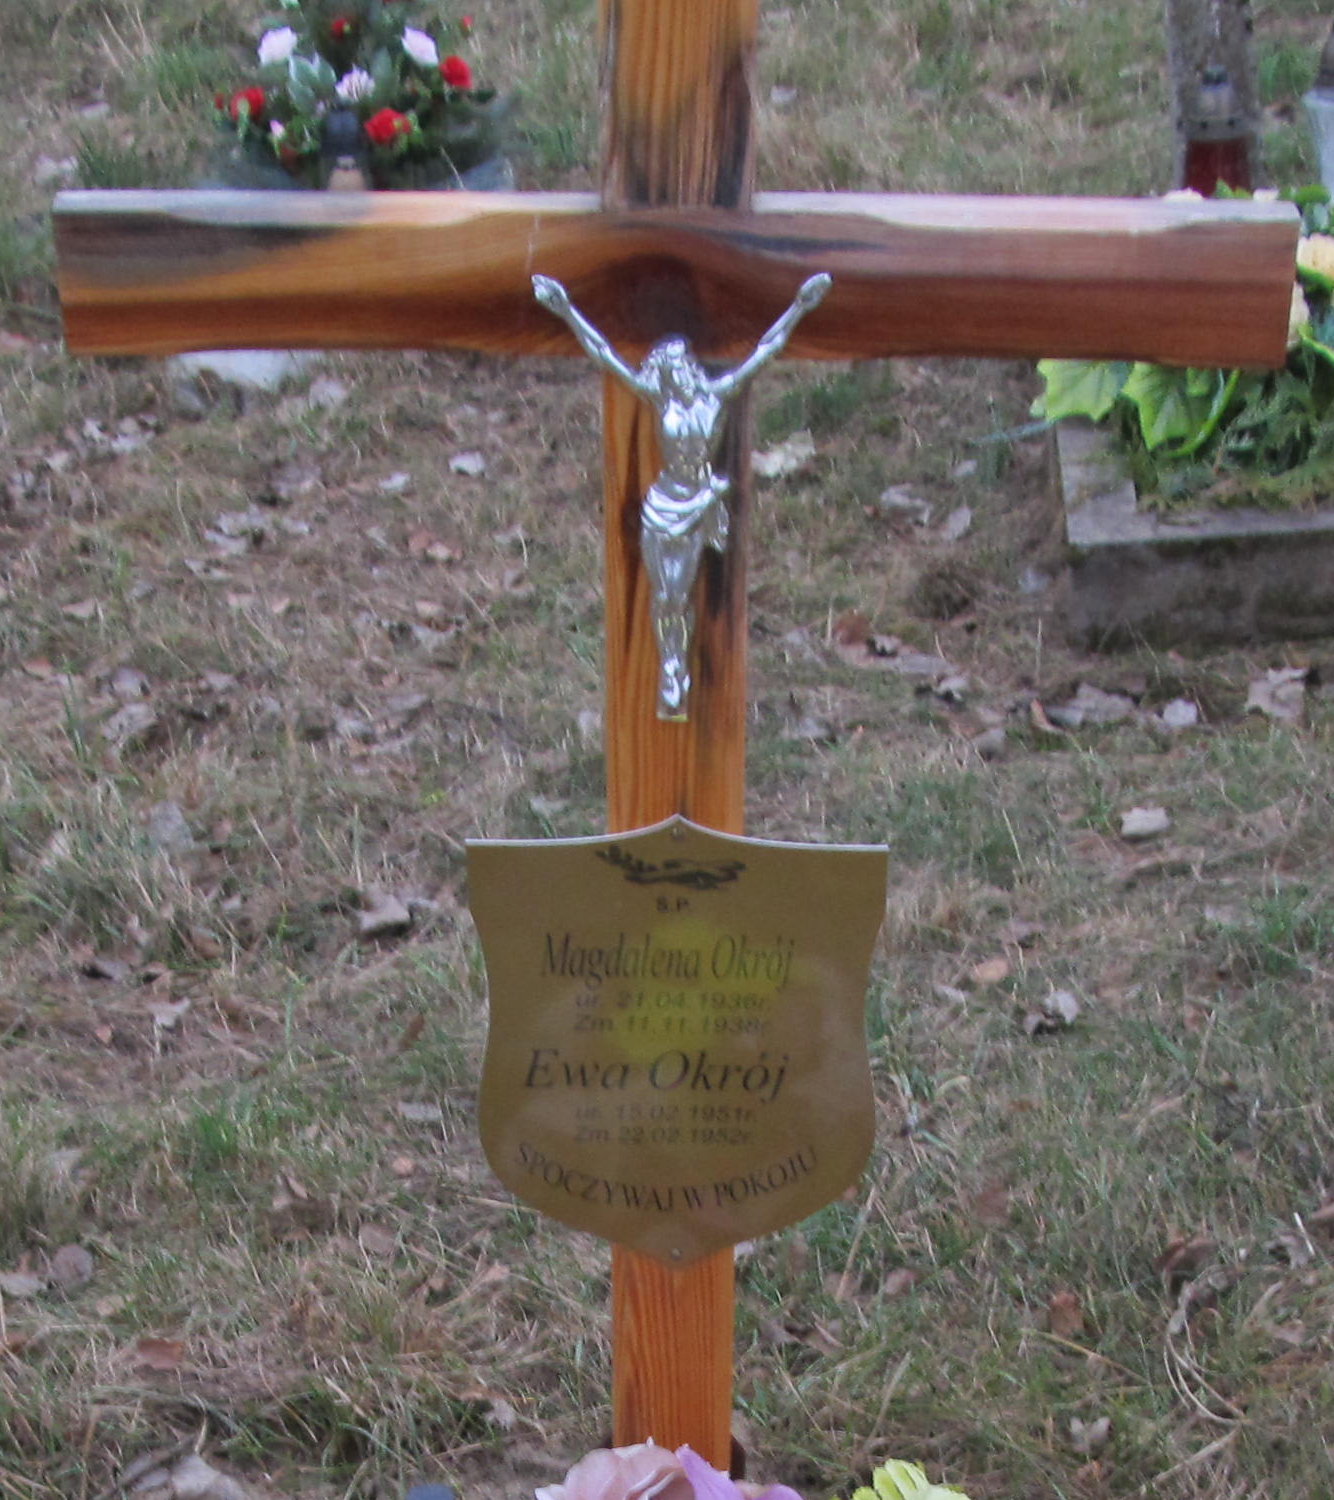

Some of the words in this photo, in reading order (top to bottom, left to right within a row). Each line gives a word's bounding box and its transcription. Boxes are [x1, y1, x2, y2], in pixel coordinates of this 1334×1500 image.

[541, 932, 701, 988] Magdalena
[711, 933, 796, 994] Okrój
[525, 1048, 631, 1089] Ewa
[649, 1049, 790, 1103] Okrój
[515, 1141, 674, 1213] SPOCZYWAJ
[681, 1186, 707, 1209] W
[713, 1145, 818, 1207] POKOJU
